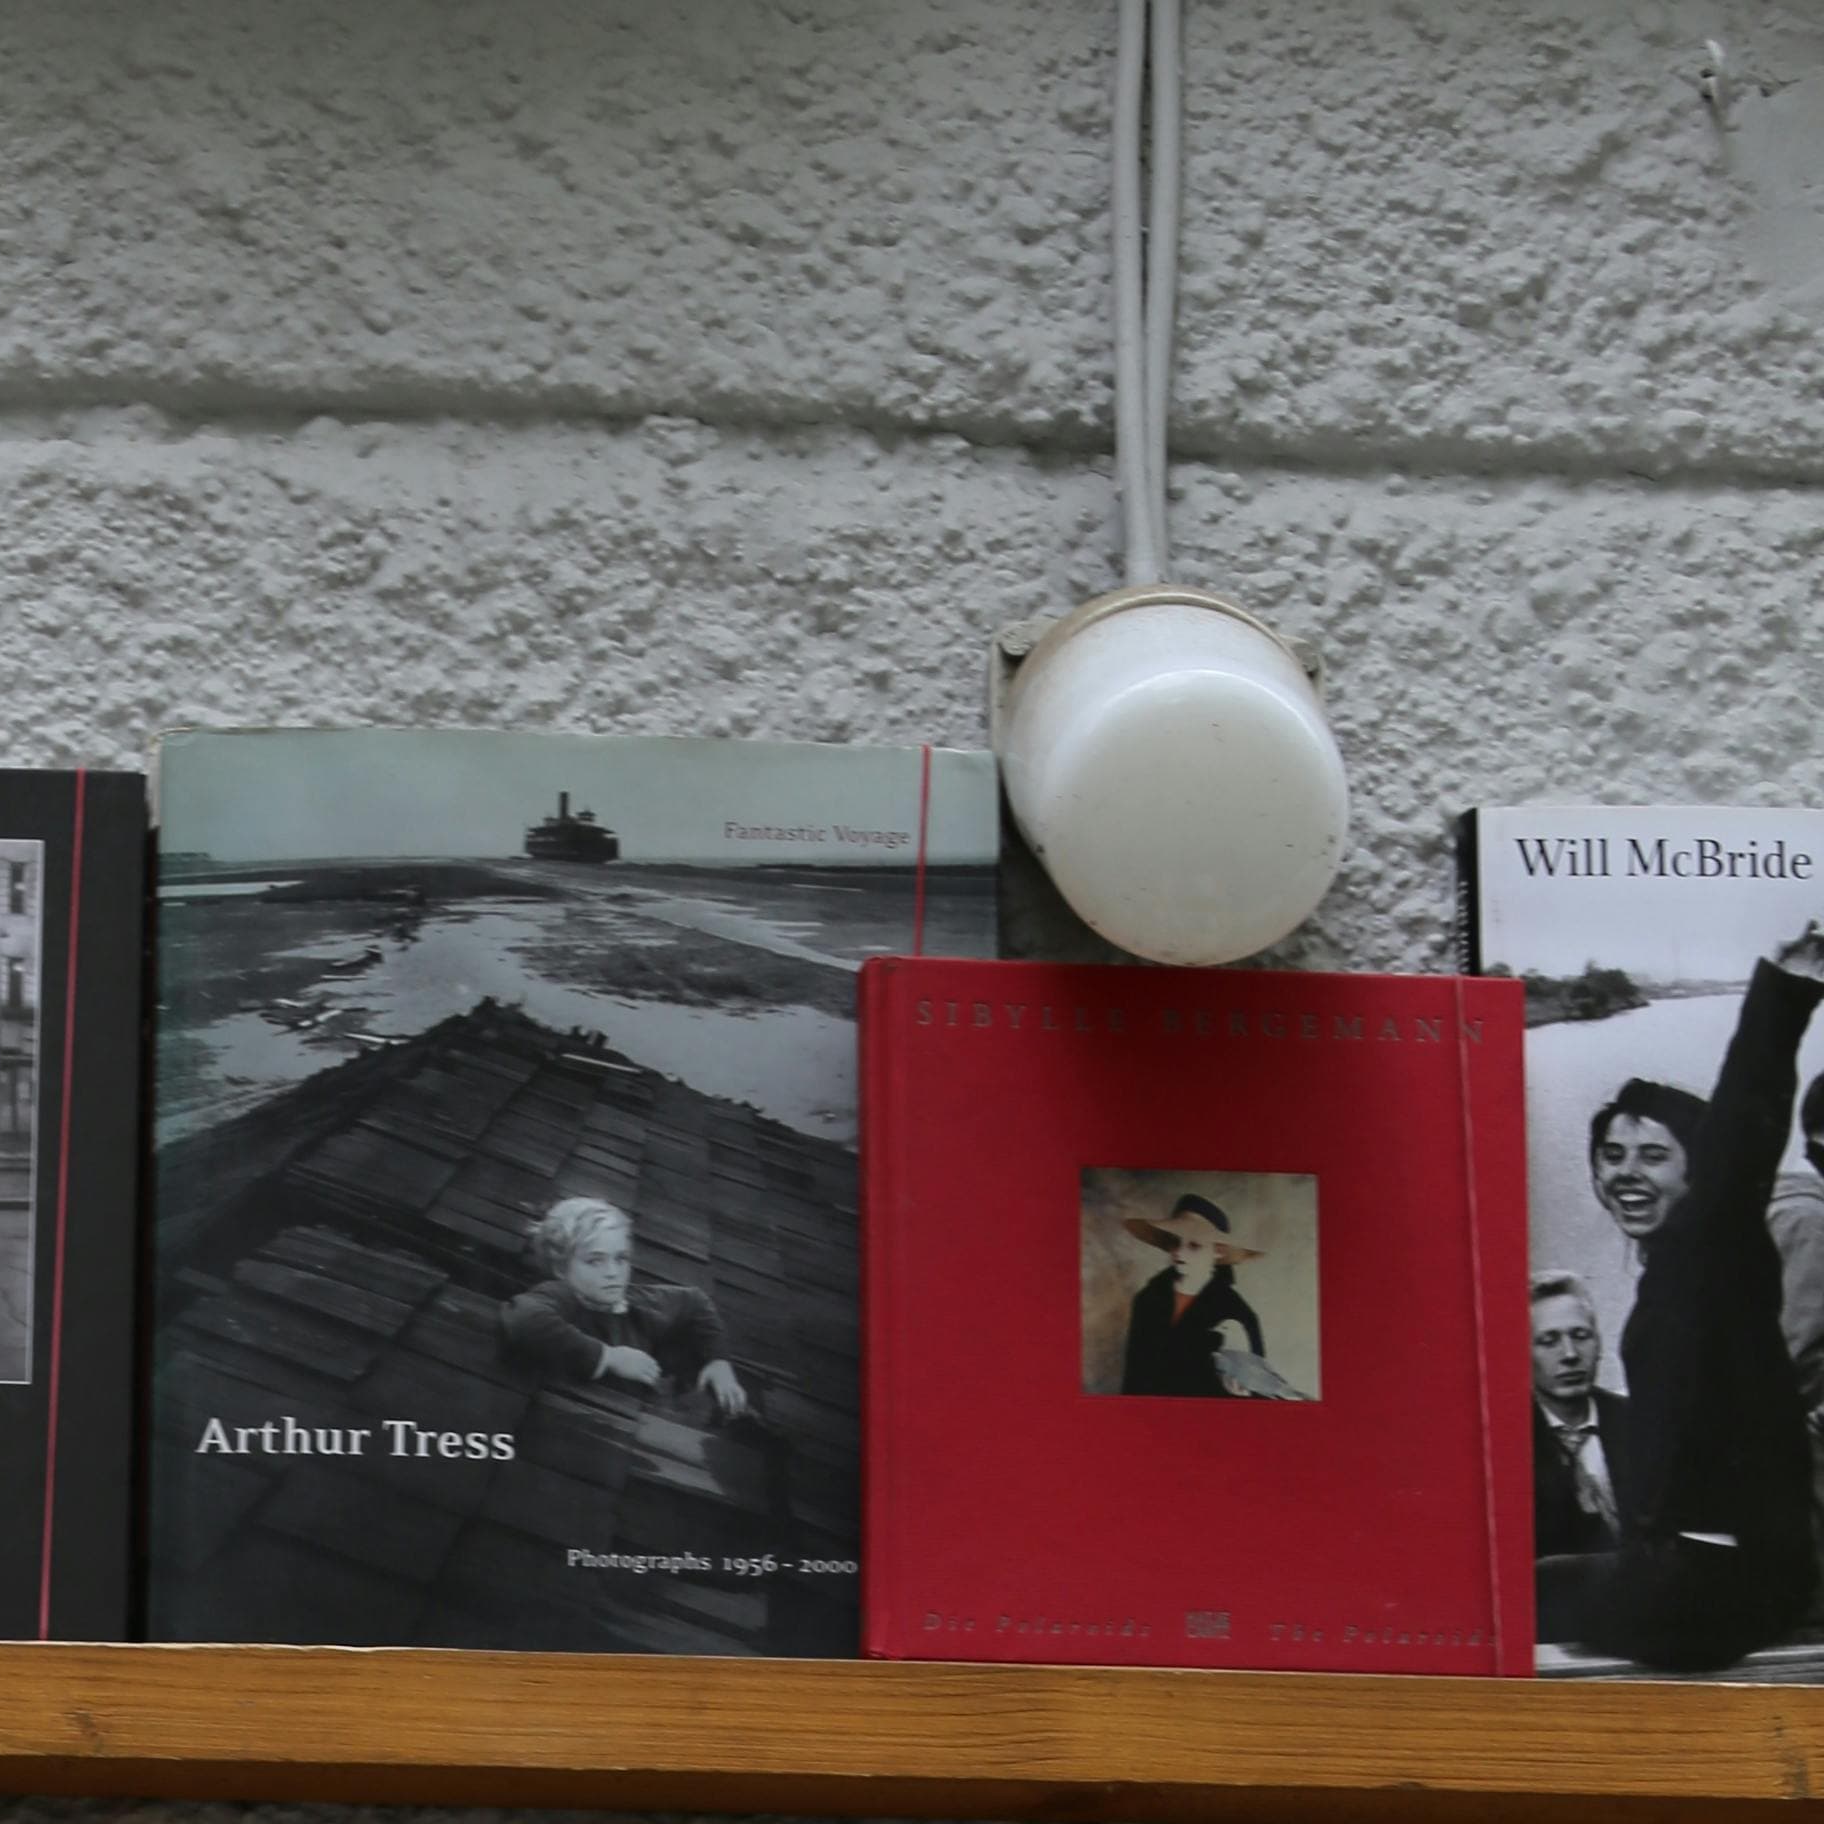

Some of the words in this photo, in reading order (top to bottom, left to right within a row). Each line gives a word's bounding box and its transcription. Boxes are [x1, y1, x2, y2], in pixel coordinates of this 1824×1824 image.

[723, 820, 826, 844] Fantastic
[832, 825, 910, 849] Voyage
[1514, 838, 1611, 877] Will
[1626, 838, 1813, 880] McBride
[915, 1000, 1127, 1033] SIBYLLE
[1163, 1009, 1486, 1045] BERGEMANN
[196, 1417, 370, 1457] Arthur
[384, 1420, 515, 1461] Tress
[567, 1548, 711, 1577] Photographs
[721, 1556, 775, 1577] 1956
[799, 1557, 858, 1576] 2000
